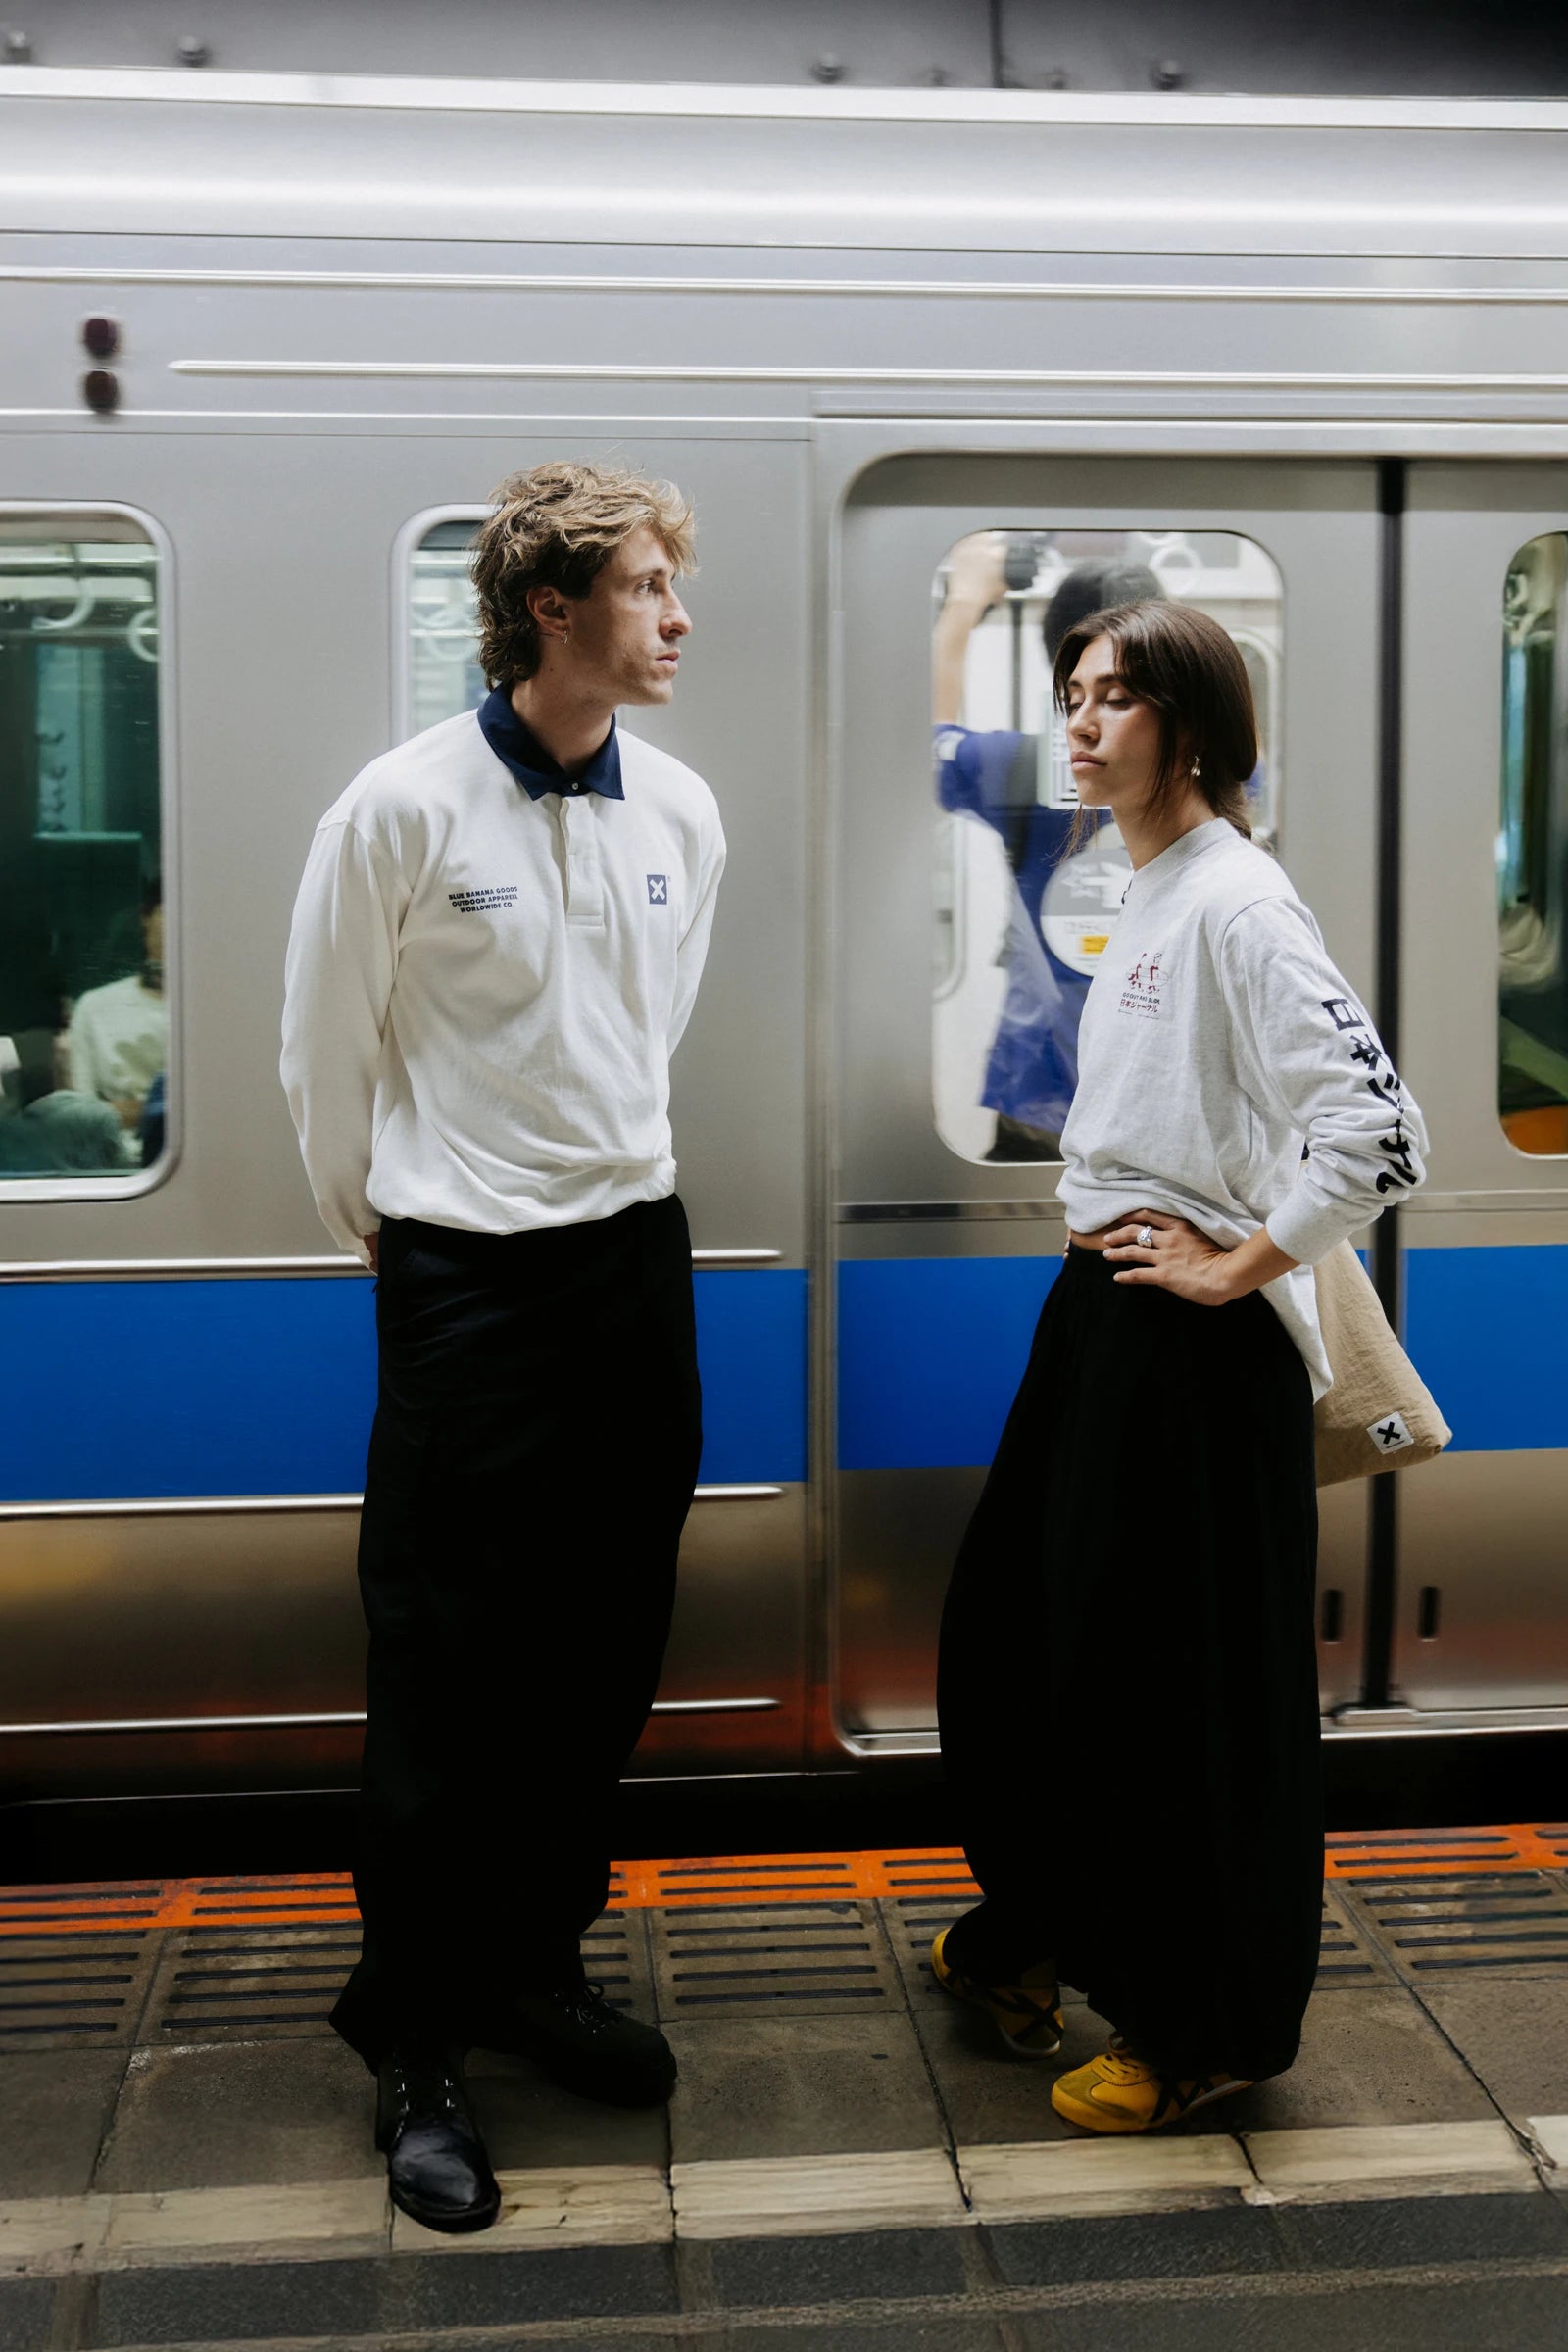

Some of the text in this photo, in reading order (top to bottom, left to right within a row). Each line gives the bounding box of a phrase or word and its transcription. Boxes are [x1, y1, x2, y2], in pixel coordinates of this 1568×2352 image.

[466, 888, 494, 898] BANANA
[451, 897, 486, 907] OUTDOOR
[460, 903, 502, 913] WORLDWIDE
